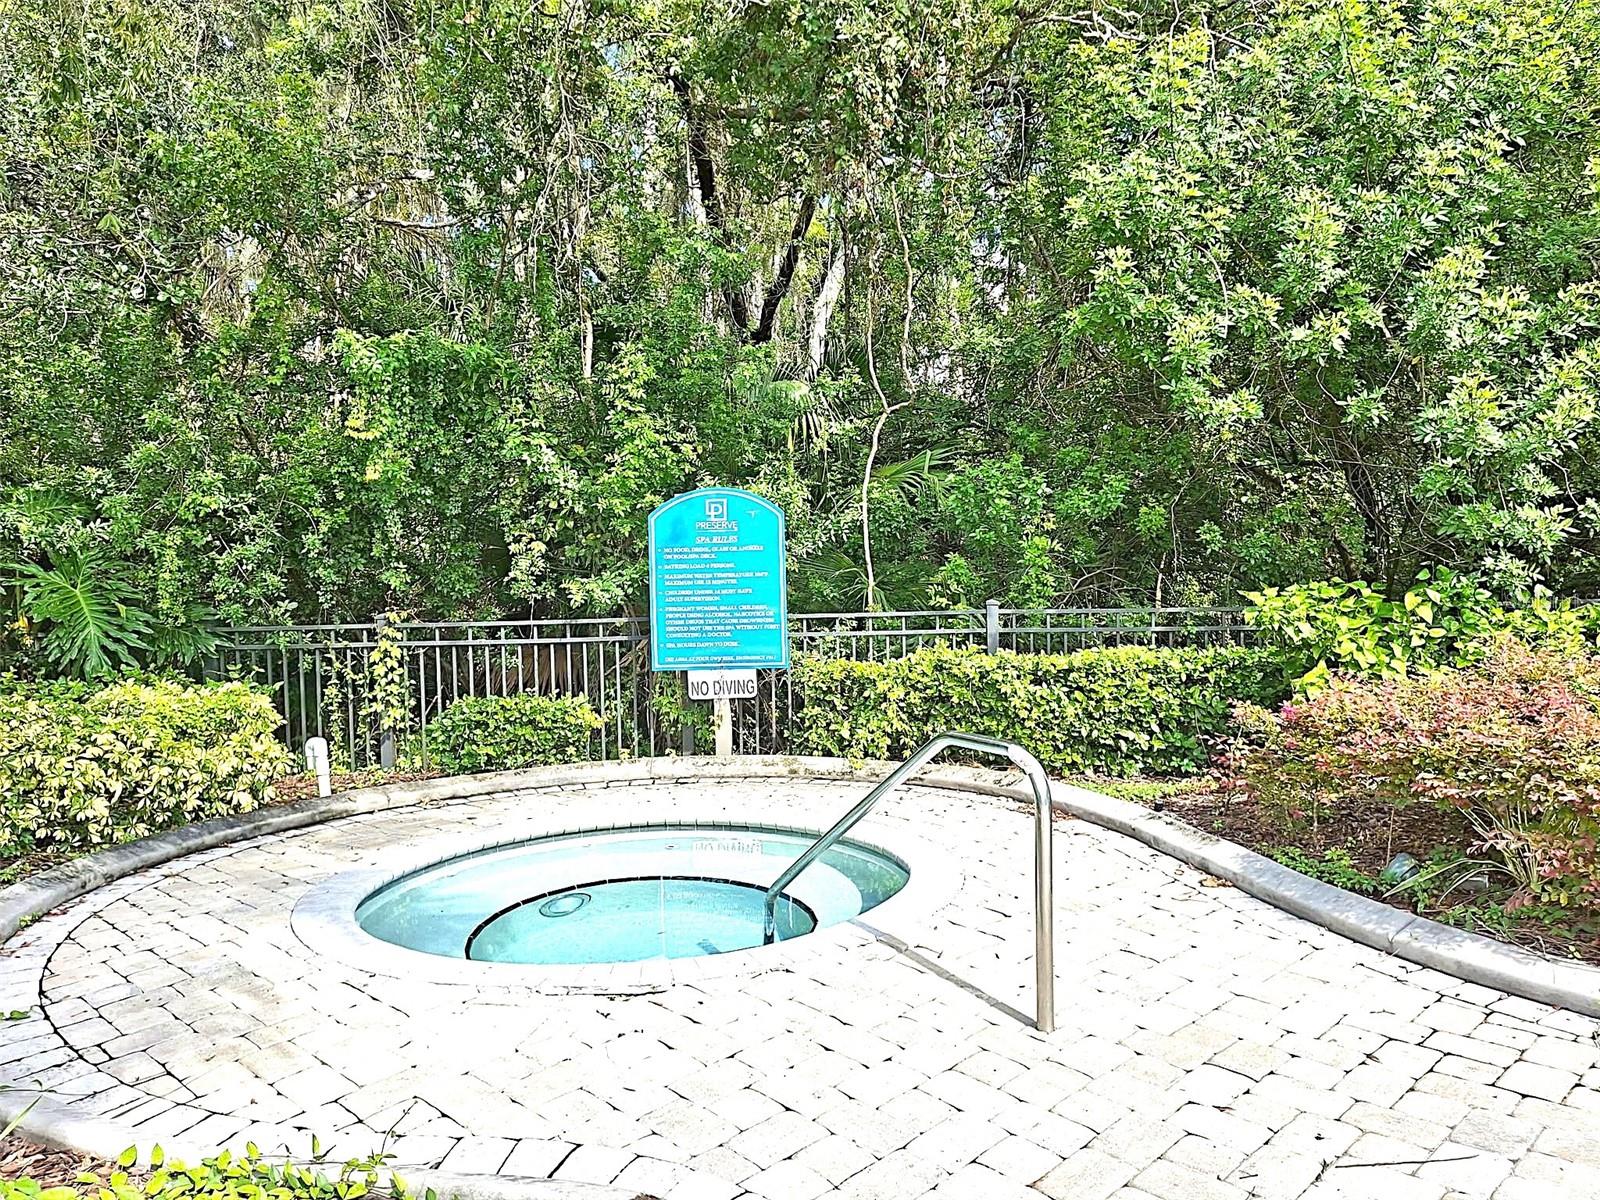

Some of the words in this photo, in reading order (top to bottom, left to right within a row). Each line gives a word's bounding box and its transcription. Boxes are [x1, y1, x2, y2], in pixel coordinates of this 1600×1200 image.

[696, 521, 738, 531] PRESERVE
[696, 536, 710, 544] SPA
[691, 681, 709, 696] NO
[713, 679, 755, 695] DIVING
